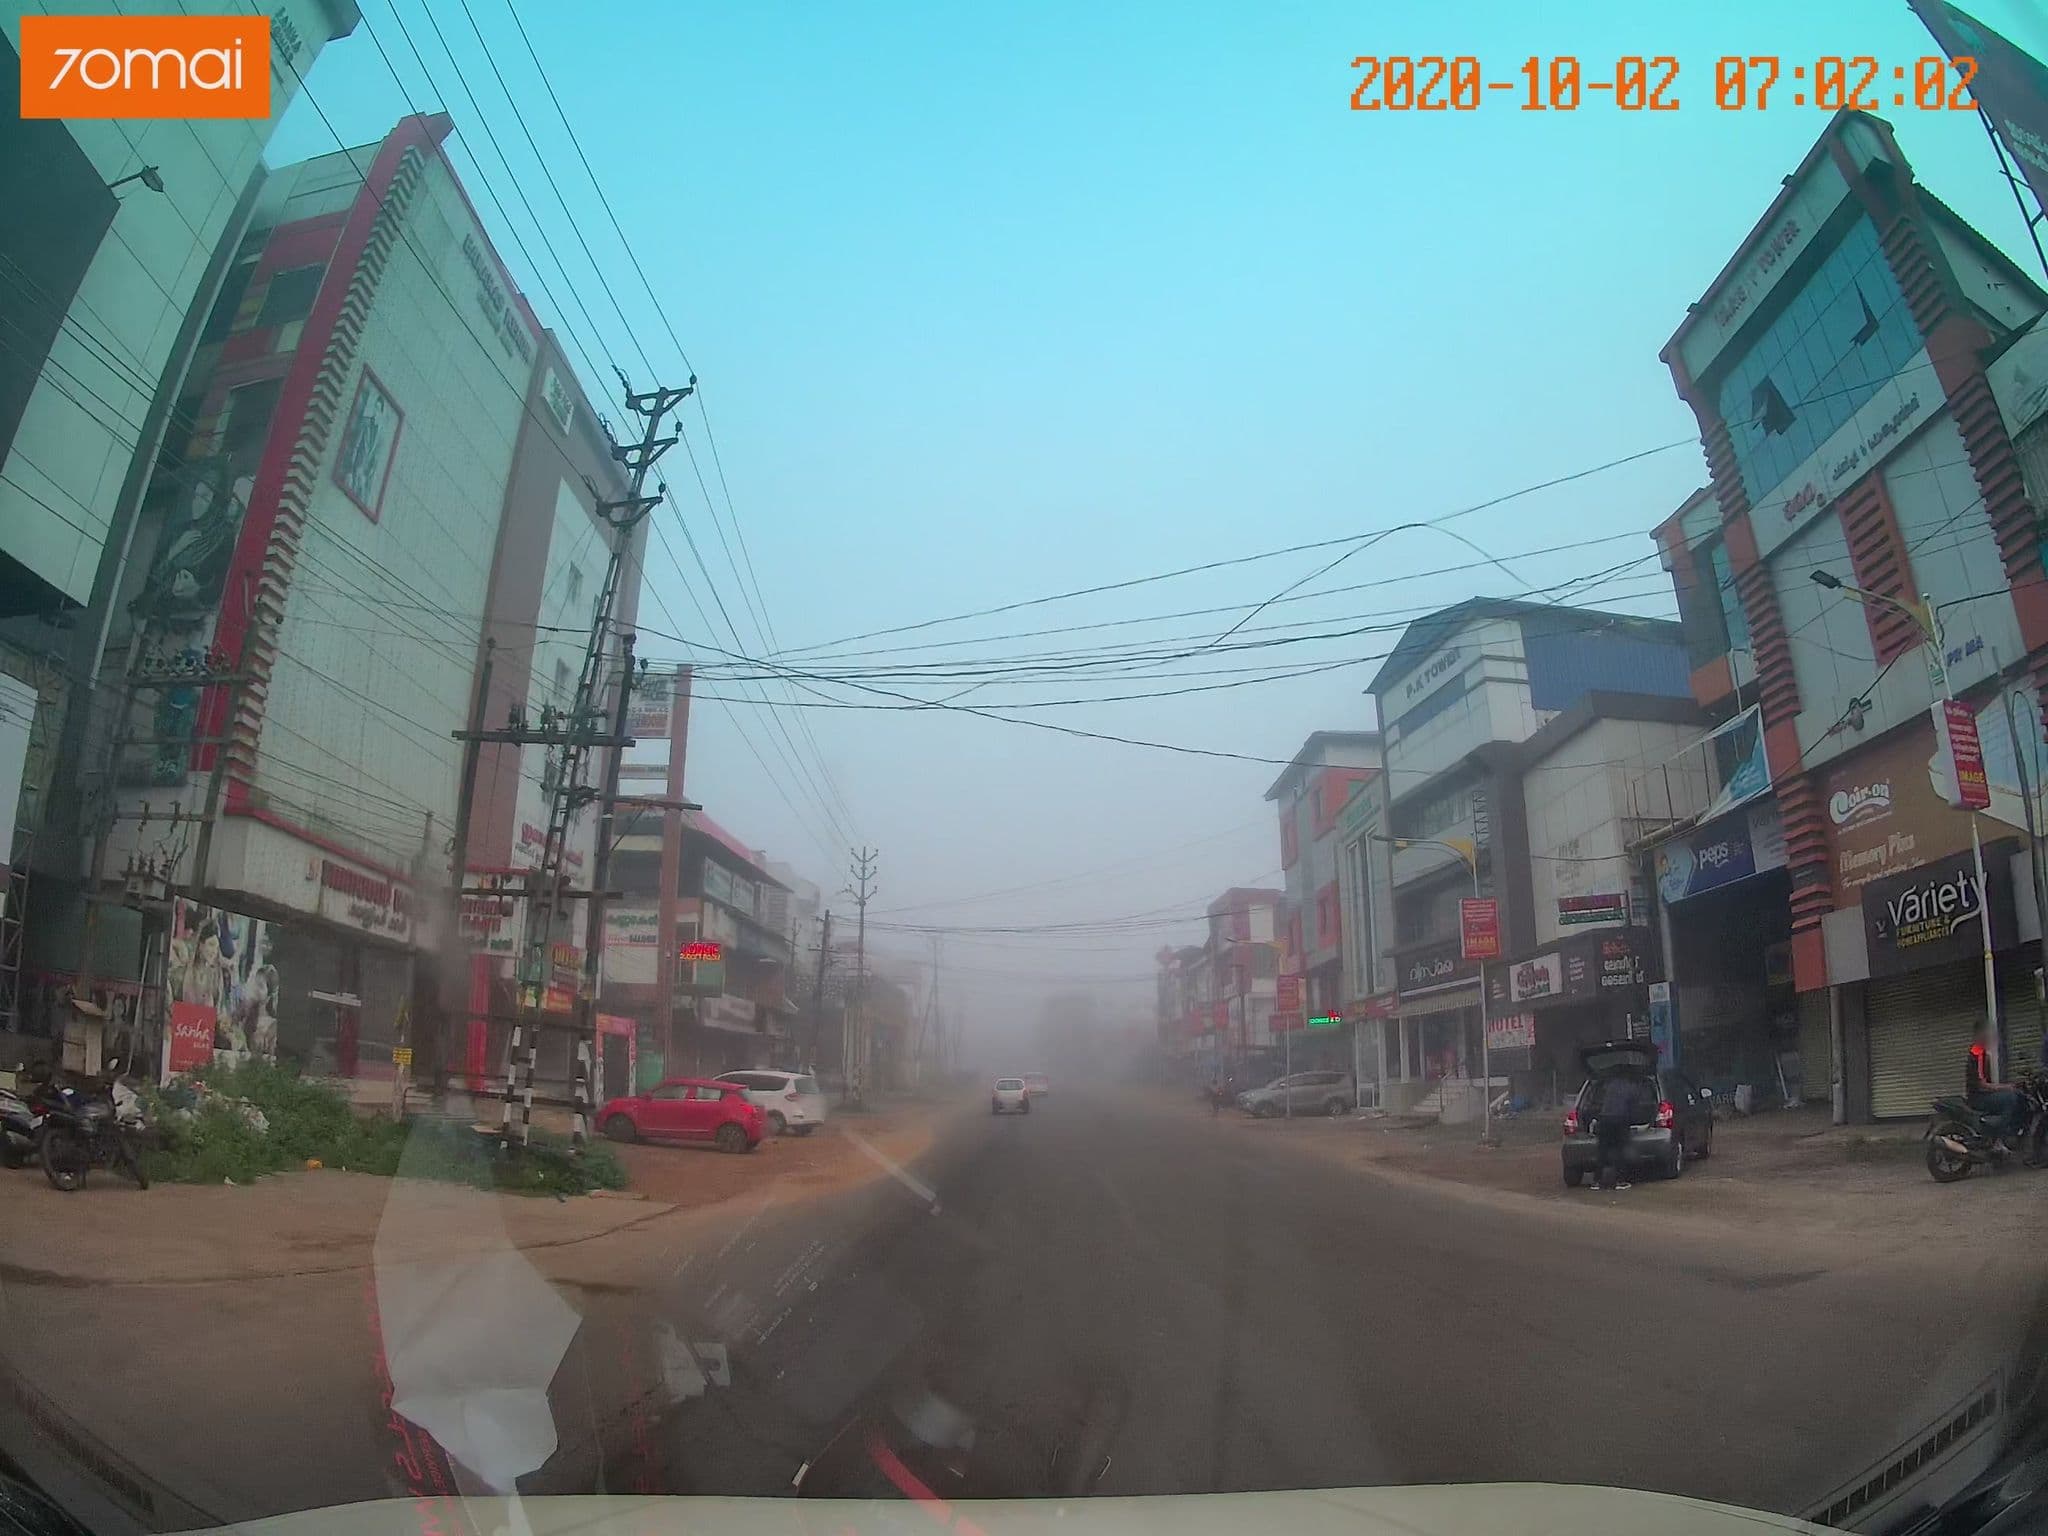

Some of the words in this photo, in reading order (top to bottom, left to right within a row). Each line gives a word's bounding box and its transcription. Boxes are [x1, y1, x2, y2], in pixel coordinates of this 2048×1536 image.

[1958, 769, 1986, 783] IMAGE
[1698, 841, 1729, 871] peps
[1887, 870, 1988, 934] Variety
[1488, 1015, 1524, 1033] HOTEL
